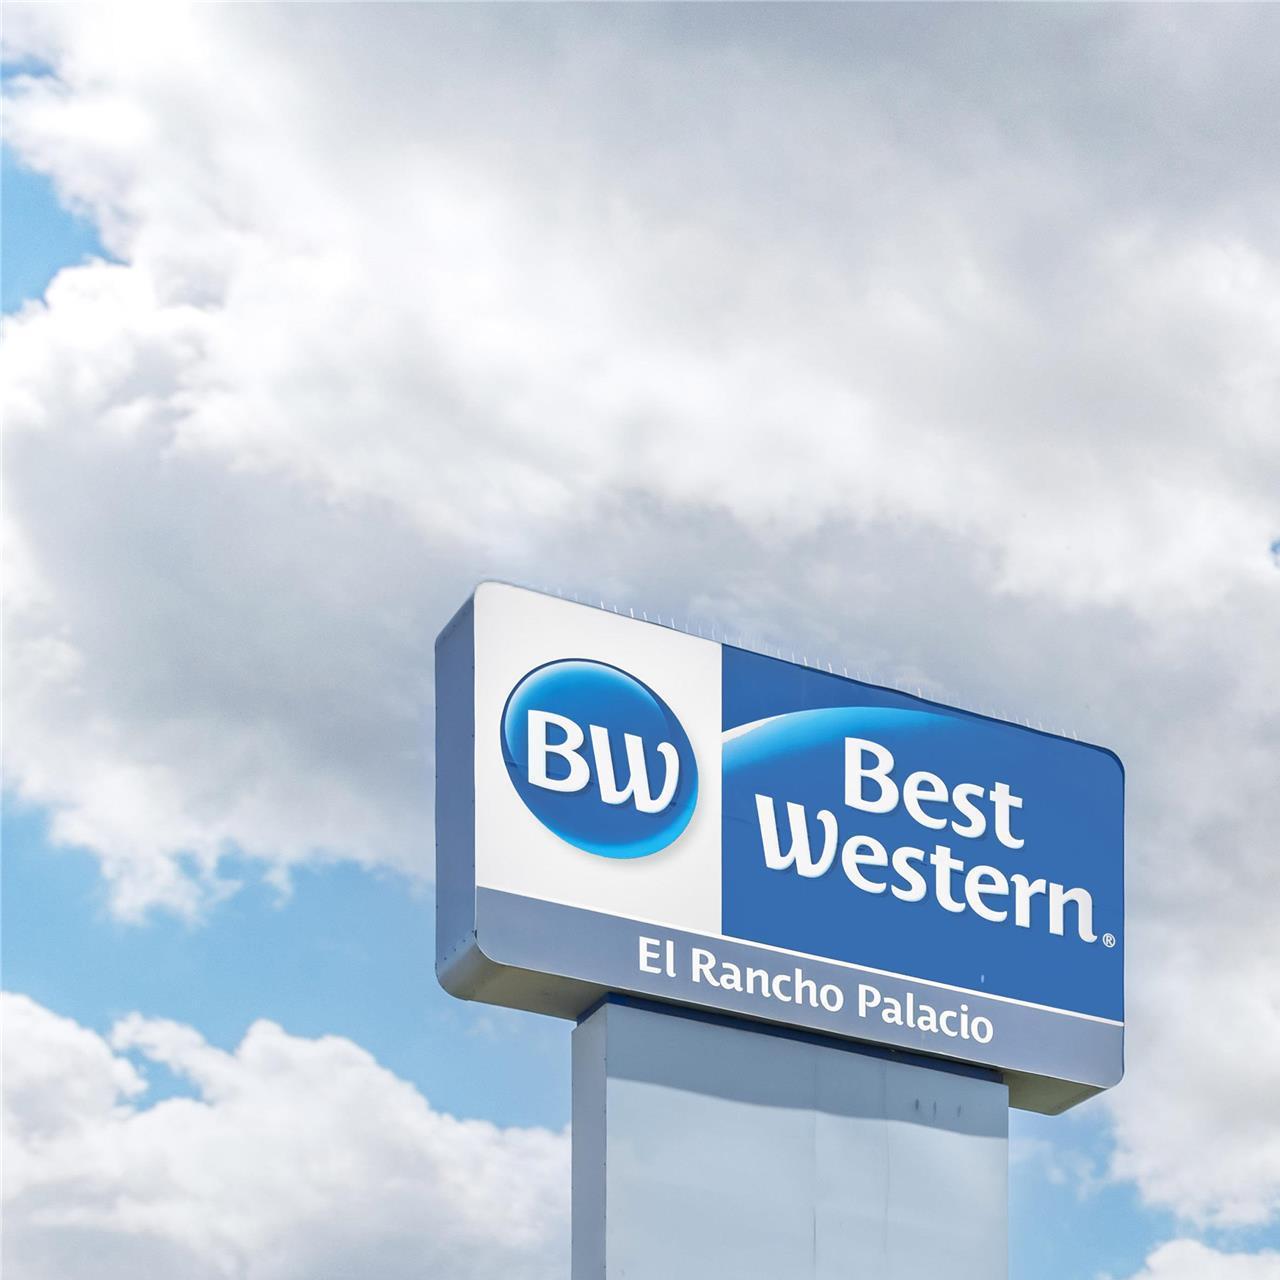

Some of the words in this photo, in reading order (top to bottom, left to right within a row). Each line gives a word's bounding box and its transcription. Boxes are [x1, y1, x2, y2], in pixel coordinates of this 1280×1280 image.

[527, 708, 679, 814] BW
[844, 736, 1025, 849] Best
[755, 793, 1098, 943] Western
[638, 936, 677, 978] El
[691, 948, 844, 1012] Rancho
[857, 984, 994, 1044] Palacio
